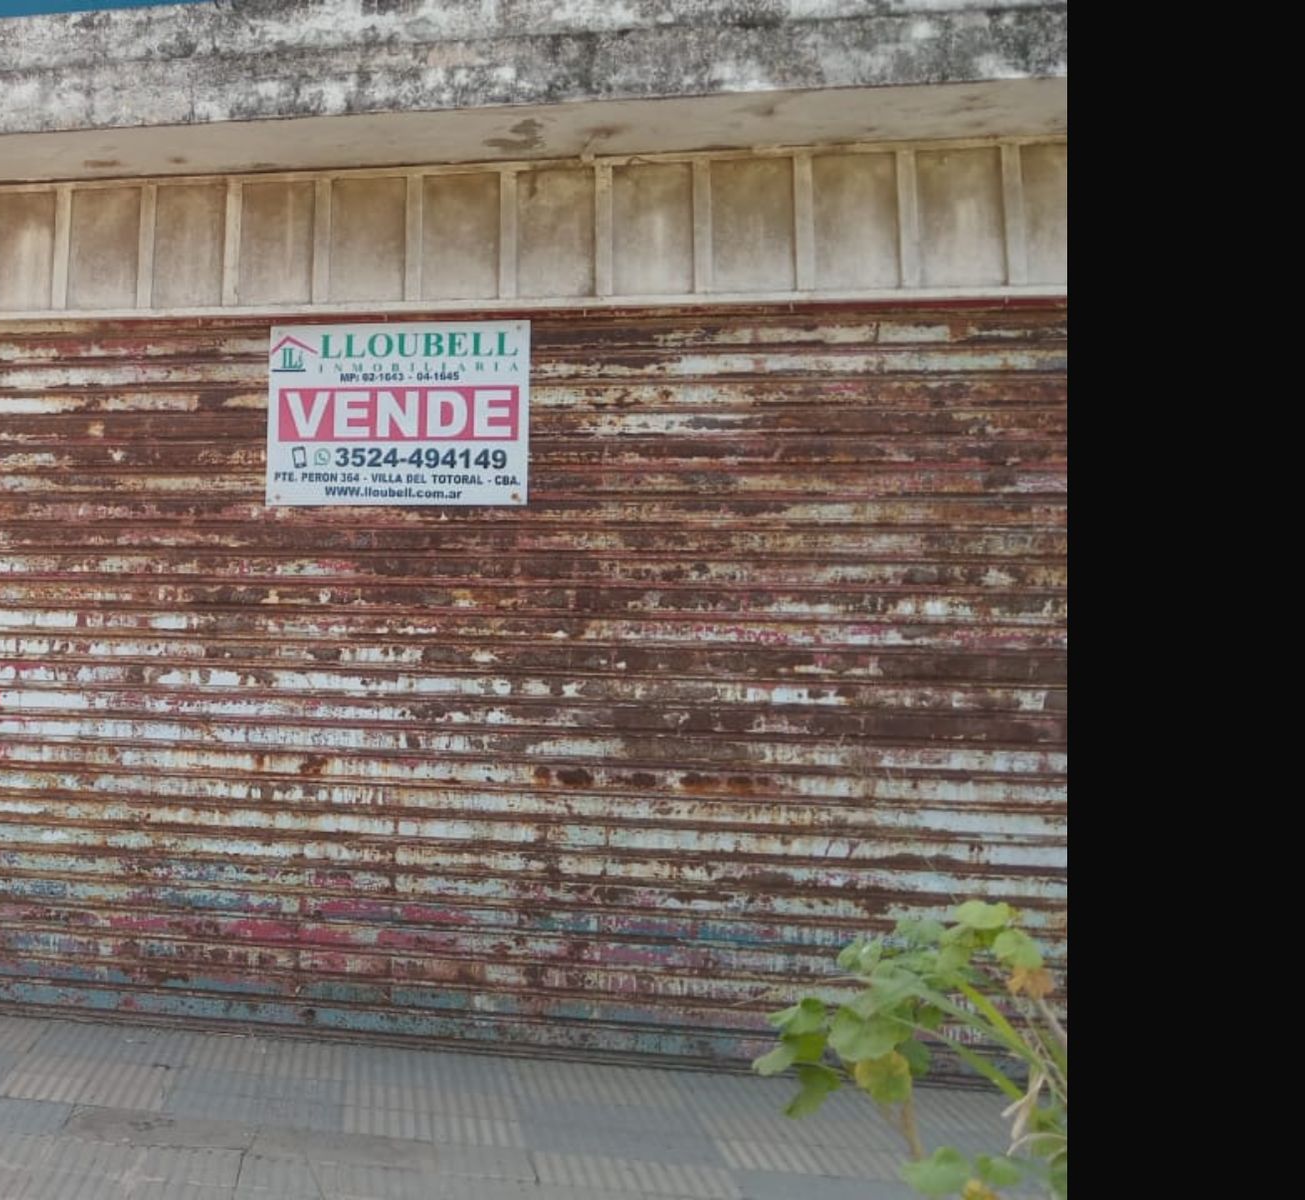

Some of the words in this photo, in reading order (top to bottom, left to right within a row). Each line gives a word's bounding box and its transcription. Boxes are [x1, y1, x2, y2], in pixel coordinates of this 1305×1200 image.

[320, 331, 519, 359] LLOUBELL
[319, 361, 519, 374] INMOBILIARIA
[285, 389, 513, 439] VENDE
[334, 447, 508, 470] 3524-494149
[274, 472, 298, 483] PTE.
[301, 472, 338, 483] PERON
[340, 473, 360, 483] 364
[371, 473, 403, 483] VILLA
[406, 474, 427, 484] DEL
[432, 474, 484, 485] TOTORAL
[494, 475, 521, 486] CBA.
